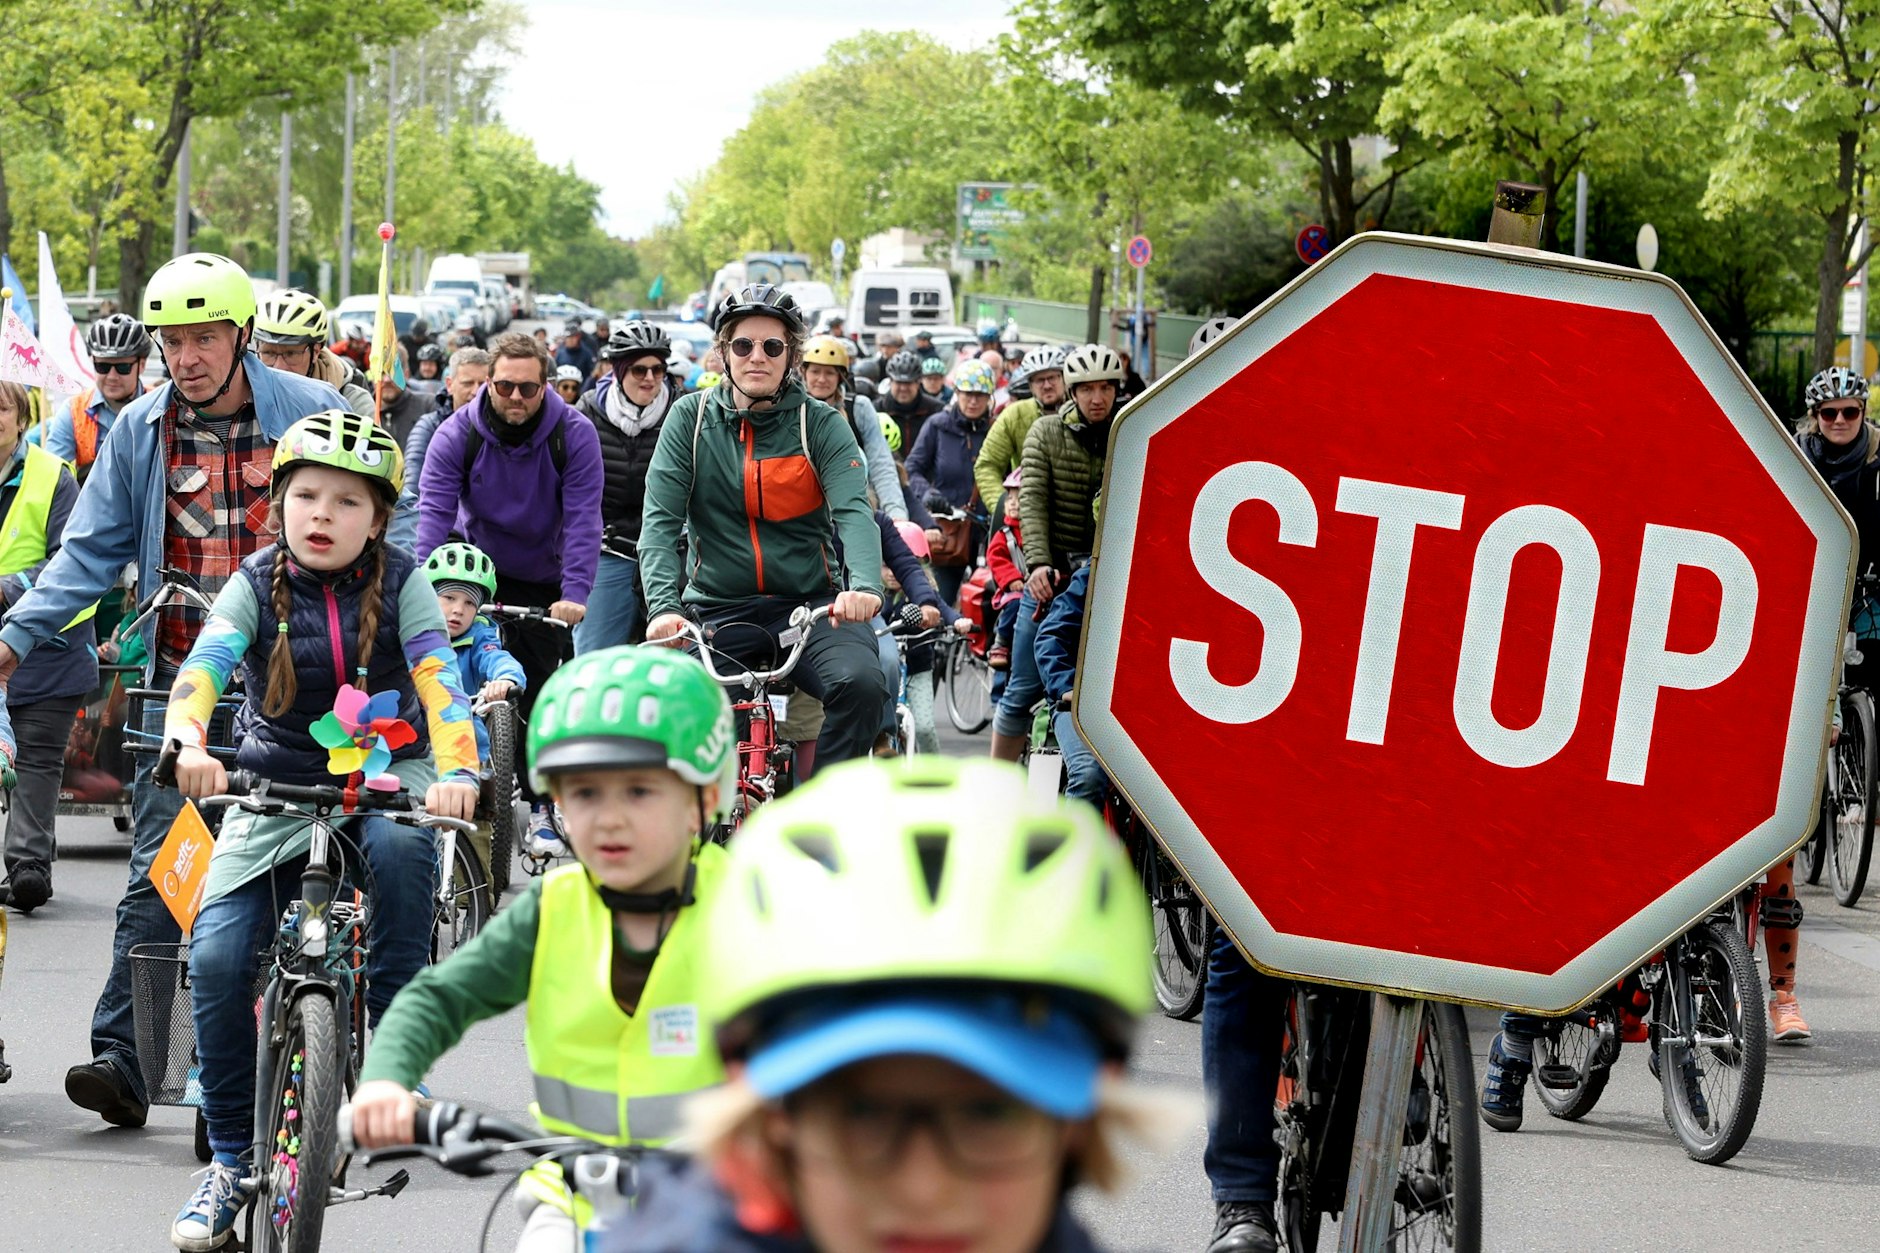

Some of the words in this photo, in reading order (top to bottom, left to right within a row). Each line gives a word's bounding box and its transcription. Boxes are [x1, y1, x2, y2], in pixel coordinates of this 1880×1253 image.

[208, 309, 230, 318] uvex
[1169, 461, 1759, 786] STOP
[173, 837, 195, 874] adfc
